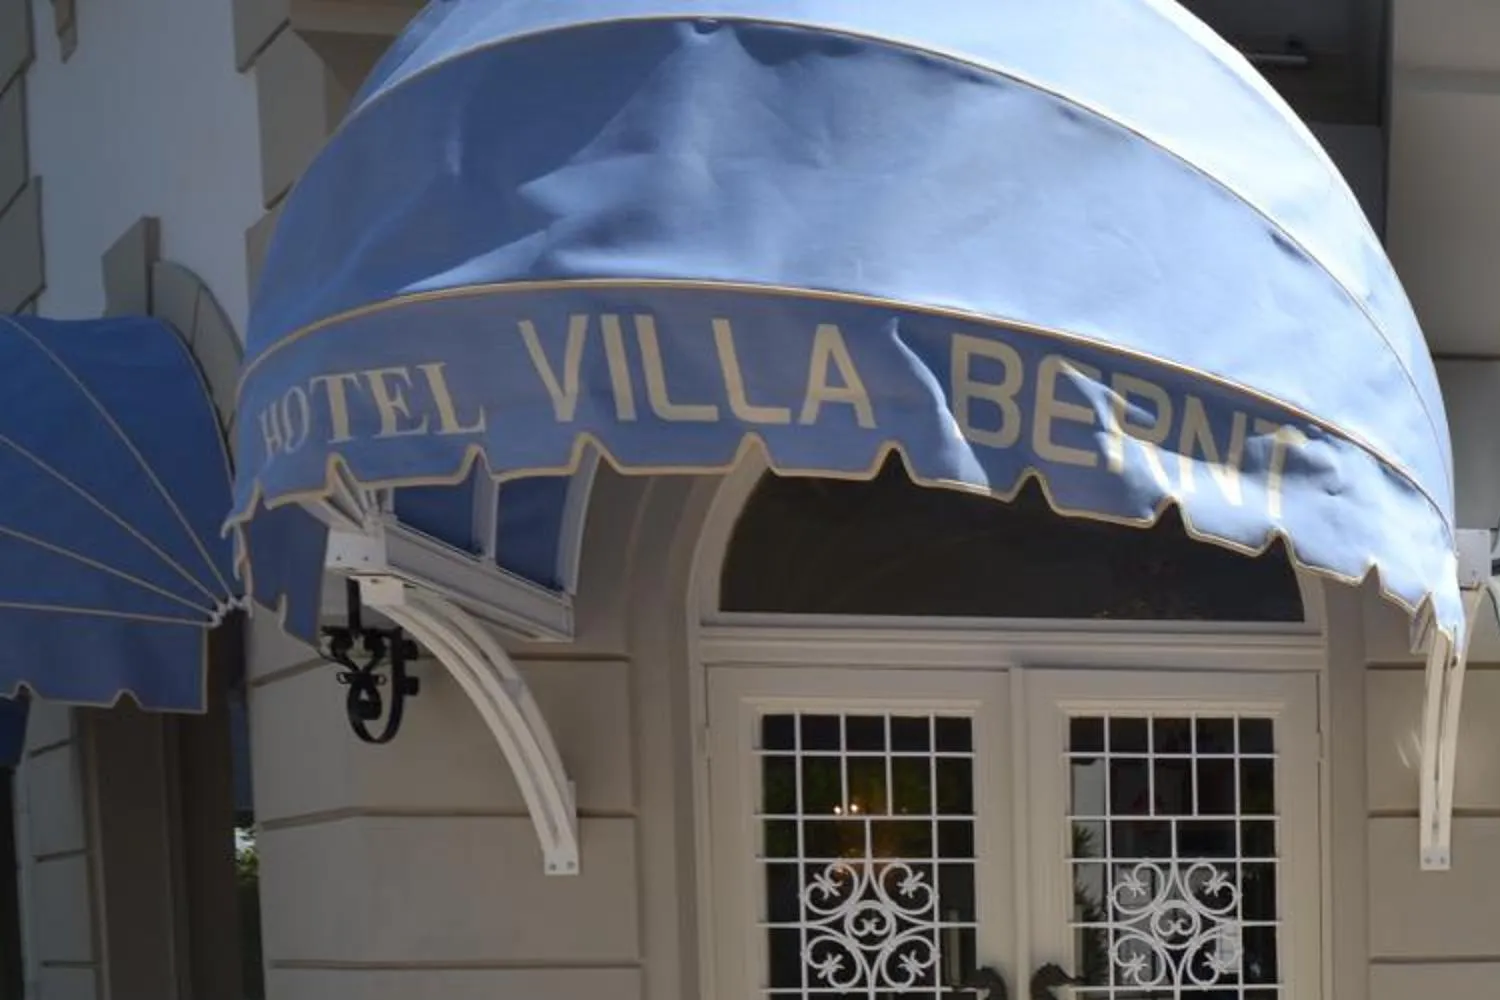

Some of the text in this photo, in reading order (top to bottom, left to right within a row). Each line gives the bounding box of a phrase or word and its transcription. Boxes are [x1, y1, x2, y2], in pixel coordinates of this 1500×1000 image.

[257, 314, 1307, 520] HOTEL VILLA BERNT
